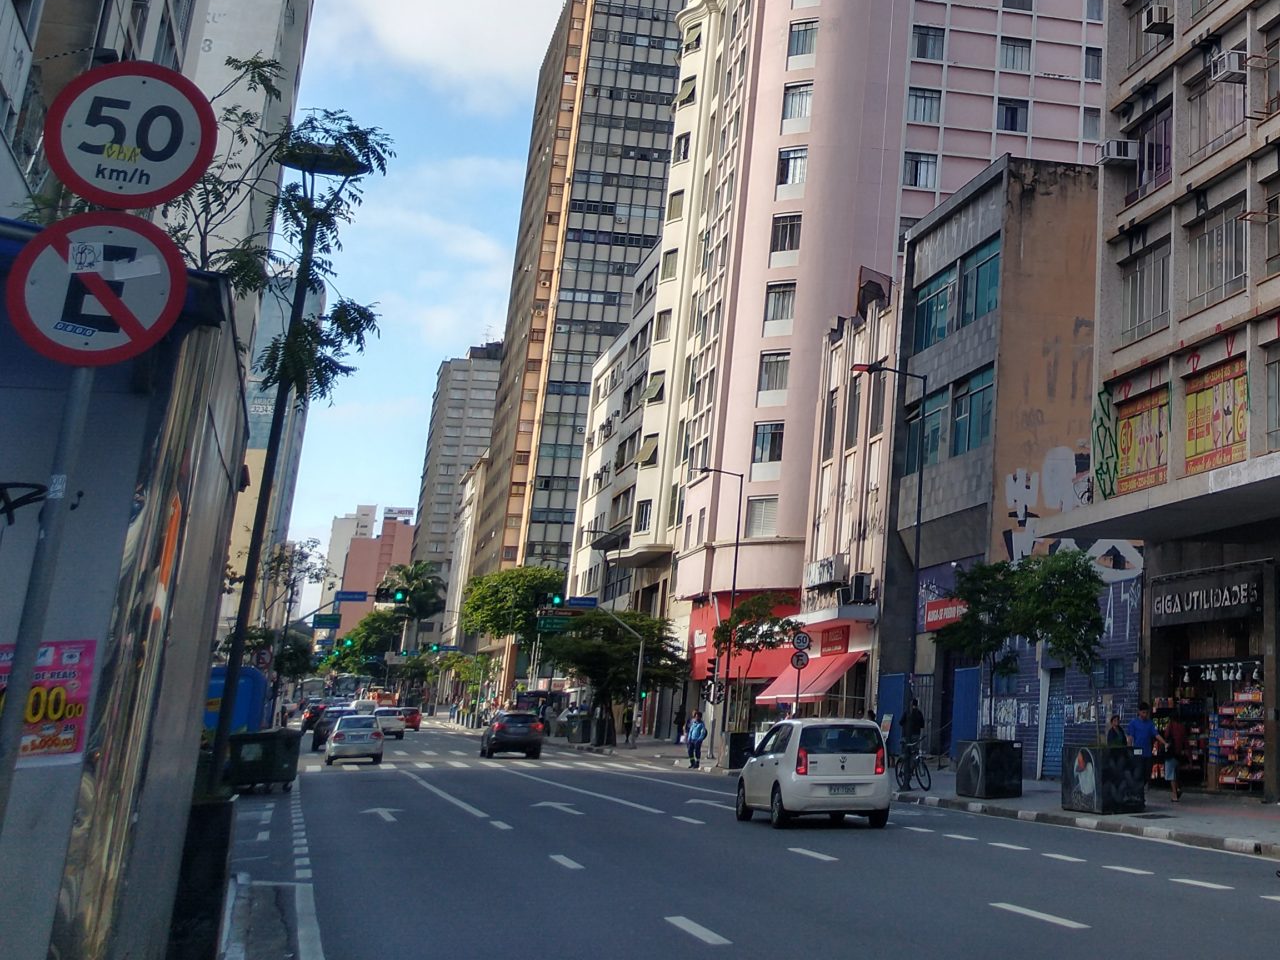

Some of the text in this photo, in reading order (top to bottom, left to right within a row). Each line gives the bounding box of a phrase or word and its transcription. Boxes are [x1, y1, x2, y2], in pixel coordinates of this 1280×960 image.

[78, 95, 183, 162] 50
[95, 163, 151, 186] km/h
[1154, 583, 1258, 615] GIGA UTILIDADES
